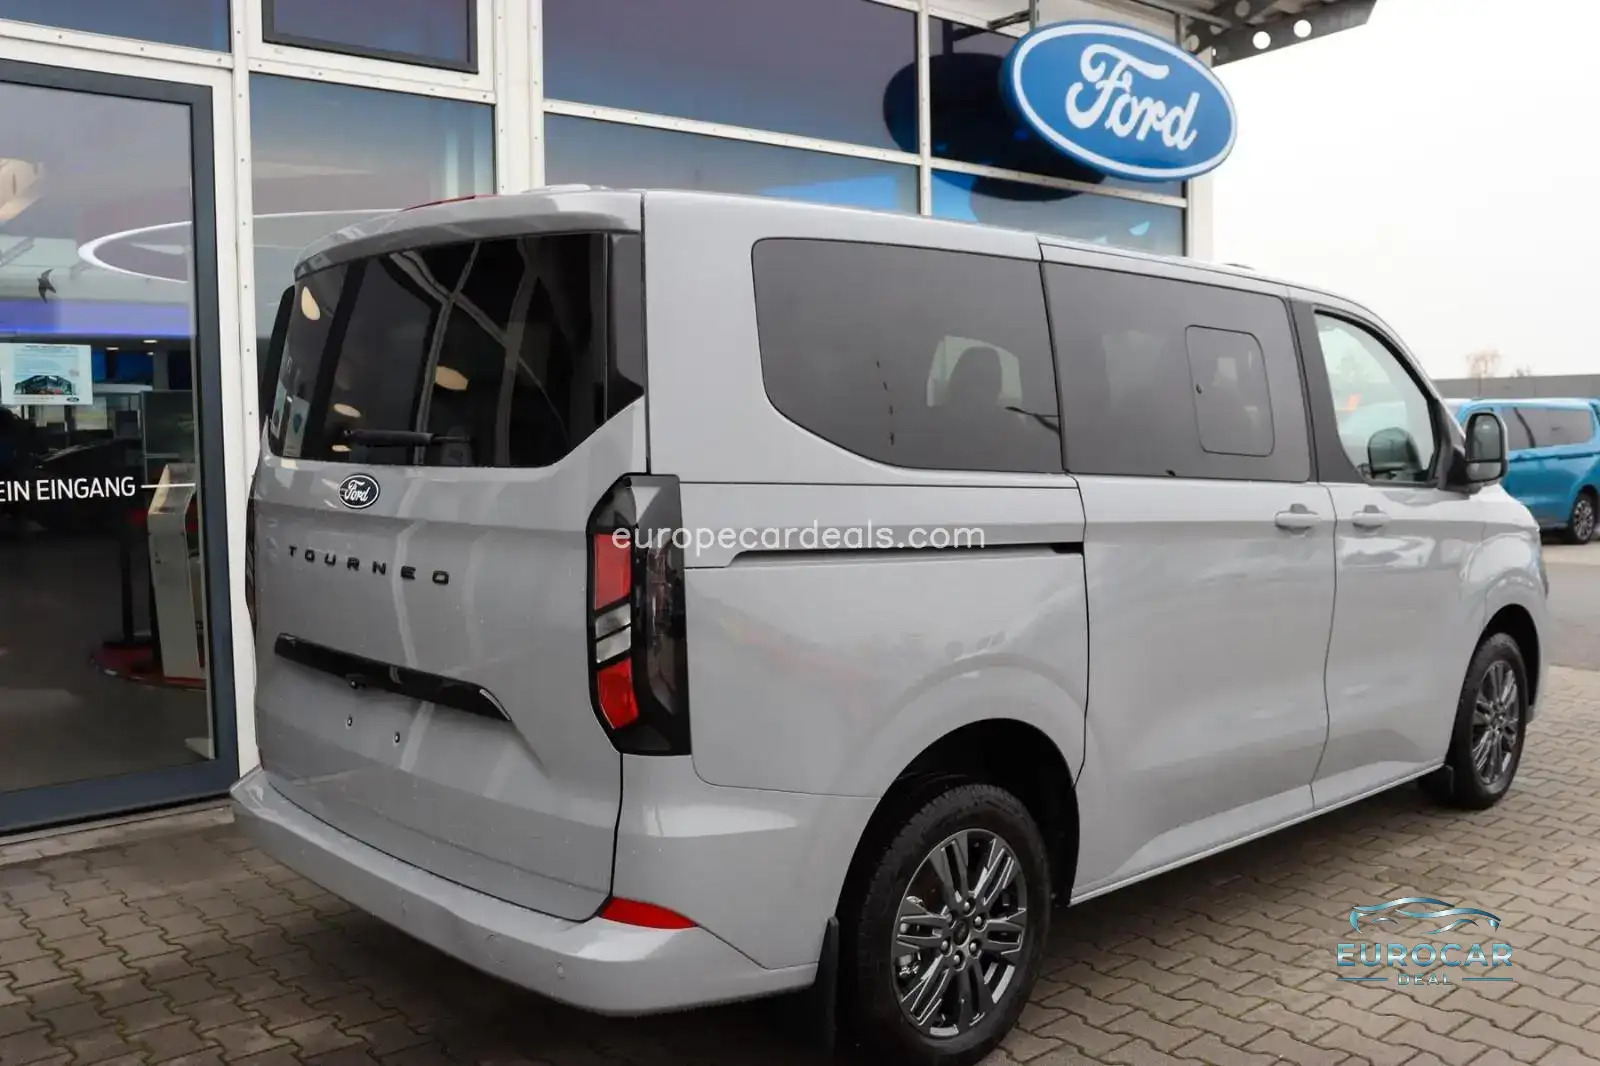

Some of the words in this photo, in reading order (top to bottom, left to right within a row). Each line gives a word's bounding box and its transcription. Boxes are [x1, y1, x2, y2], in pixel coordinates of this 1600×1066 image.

[1065, 43, 1200, 150] Ford
[36, 476, 136, 500] EINGANG
[343, 479, 370, 502] Ford
[288, 546, 449, 586] TOURNEO
